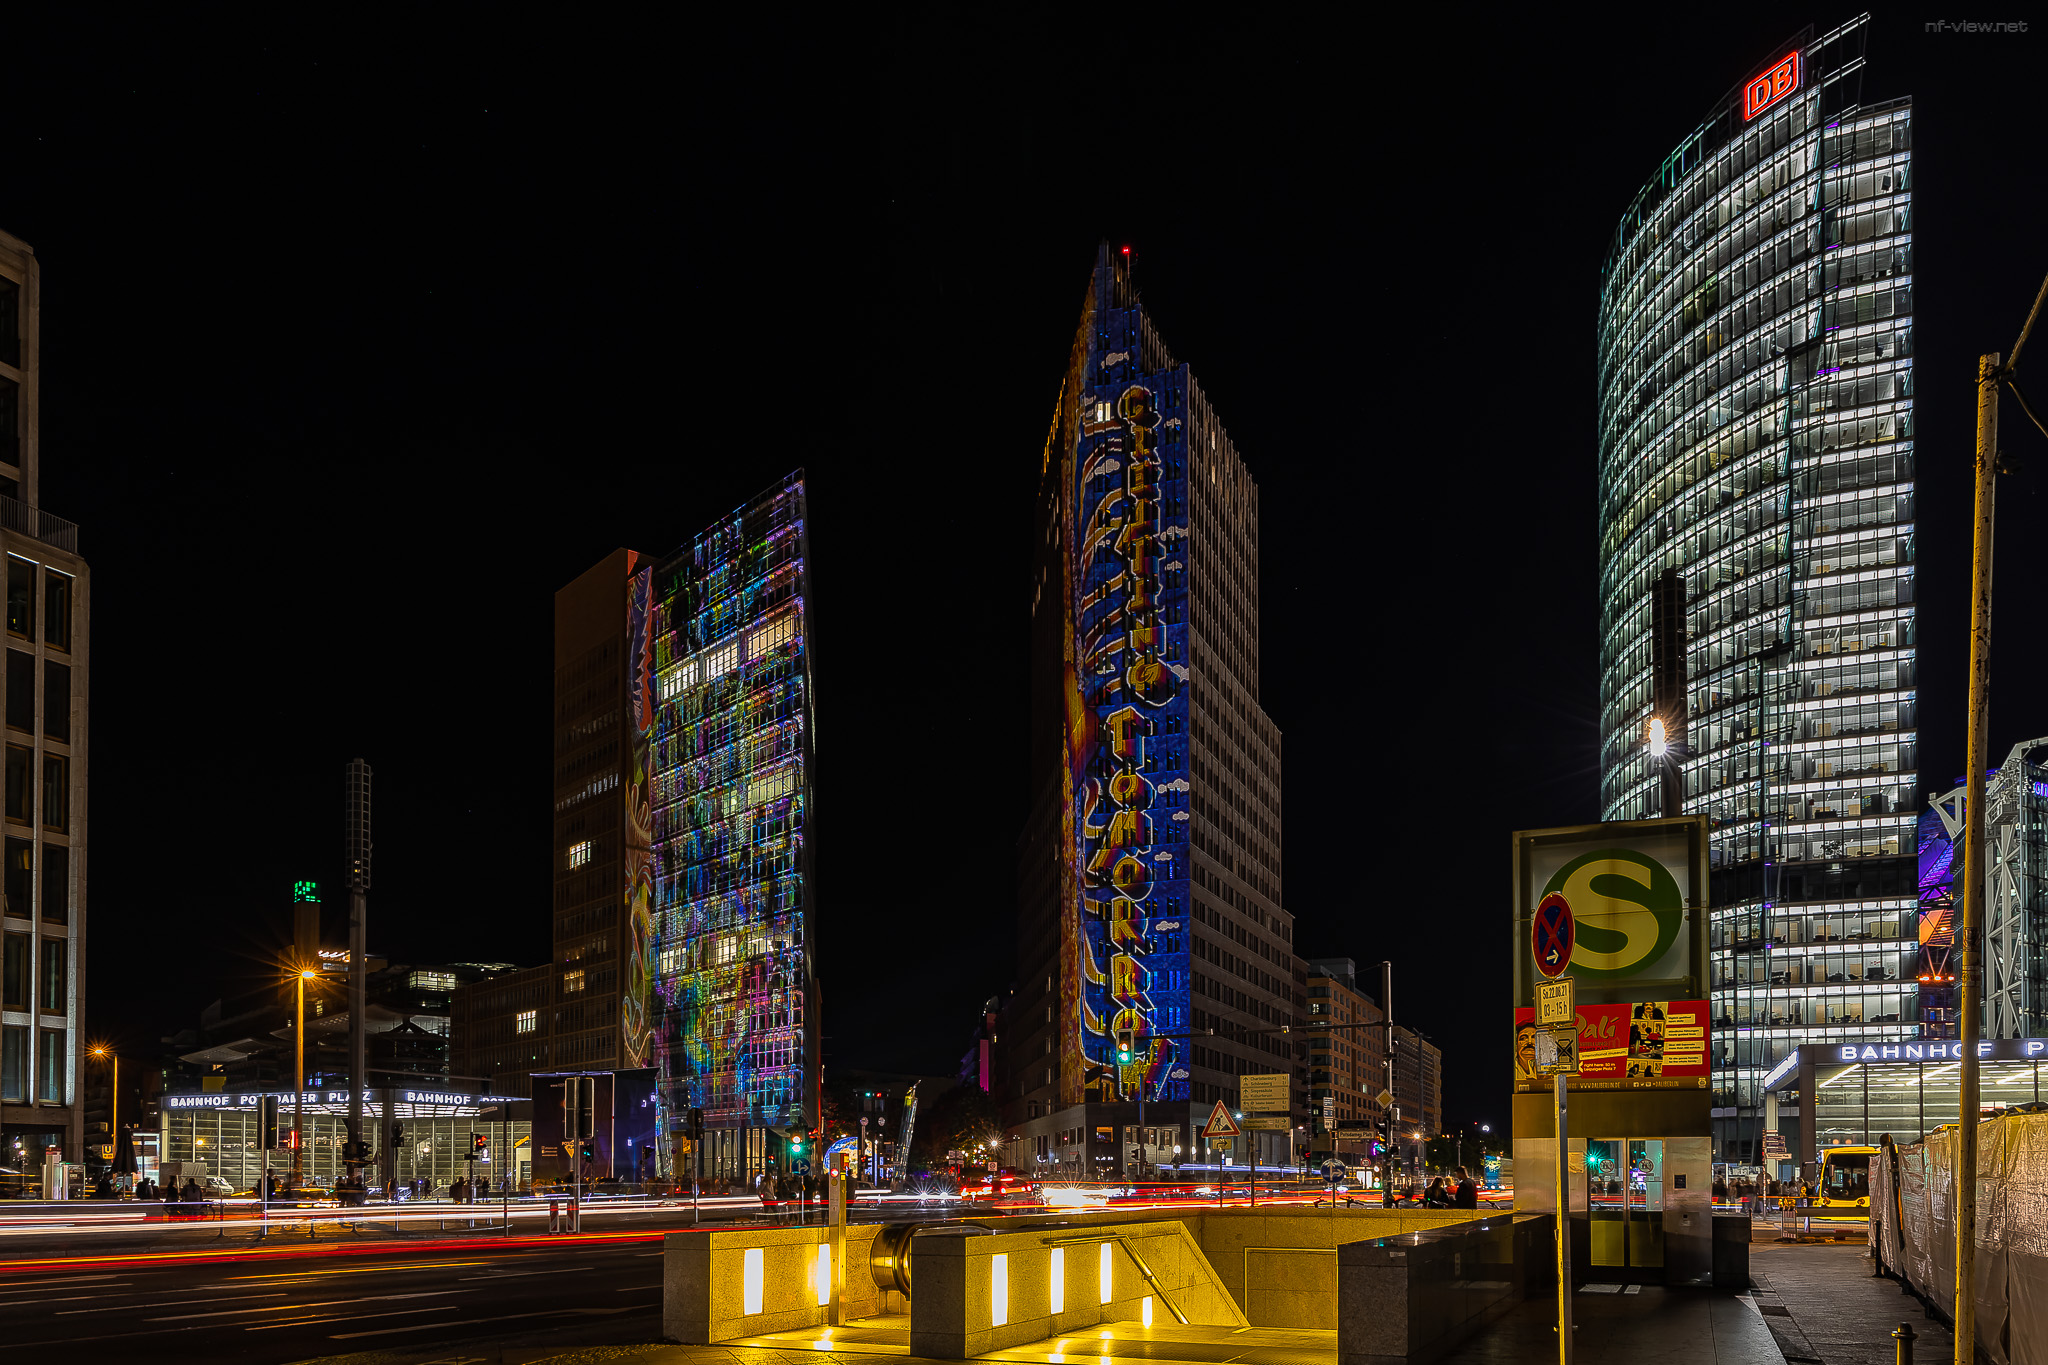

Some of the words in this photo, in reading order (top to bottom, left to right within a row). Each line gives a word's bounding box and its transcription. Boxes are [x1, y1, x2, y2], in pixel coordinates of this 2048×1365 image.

[1750, 62, 1792, 112] DB
[1562, 858, 1659, 970] S
[1543, 1003, 1551, 1017] 03
[1556, 1001, 1563, 1016] 15
[1563, 1000, 1568, 1014] h
[1840, 1042, 1993, 1060] BAHNHOF
[170, 1096, 230, 1107] BAHNHOF
[406, 1091, 471, 1105] BAHNHOF
